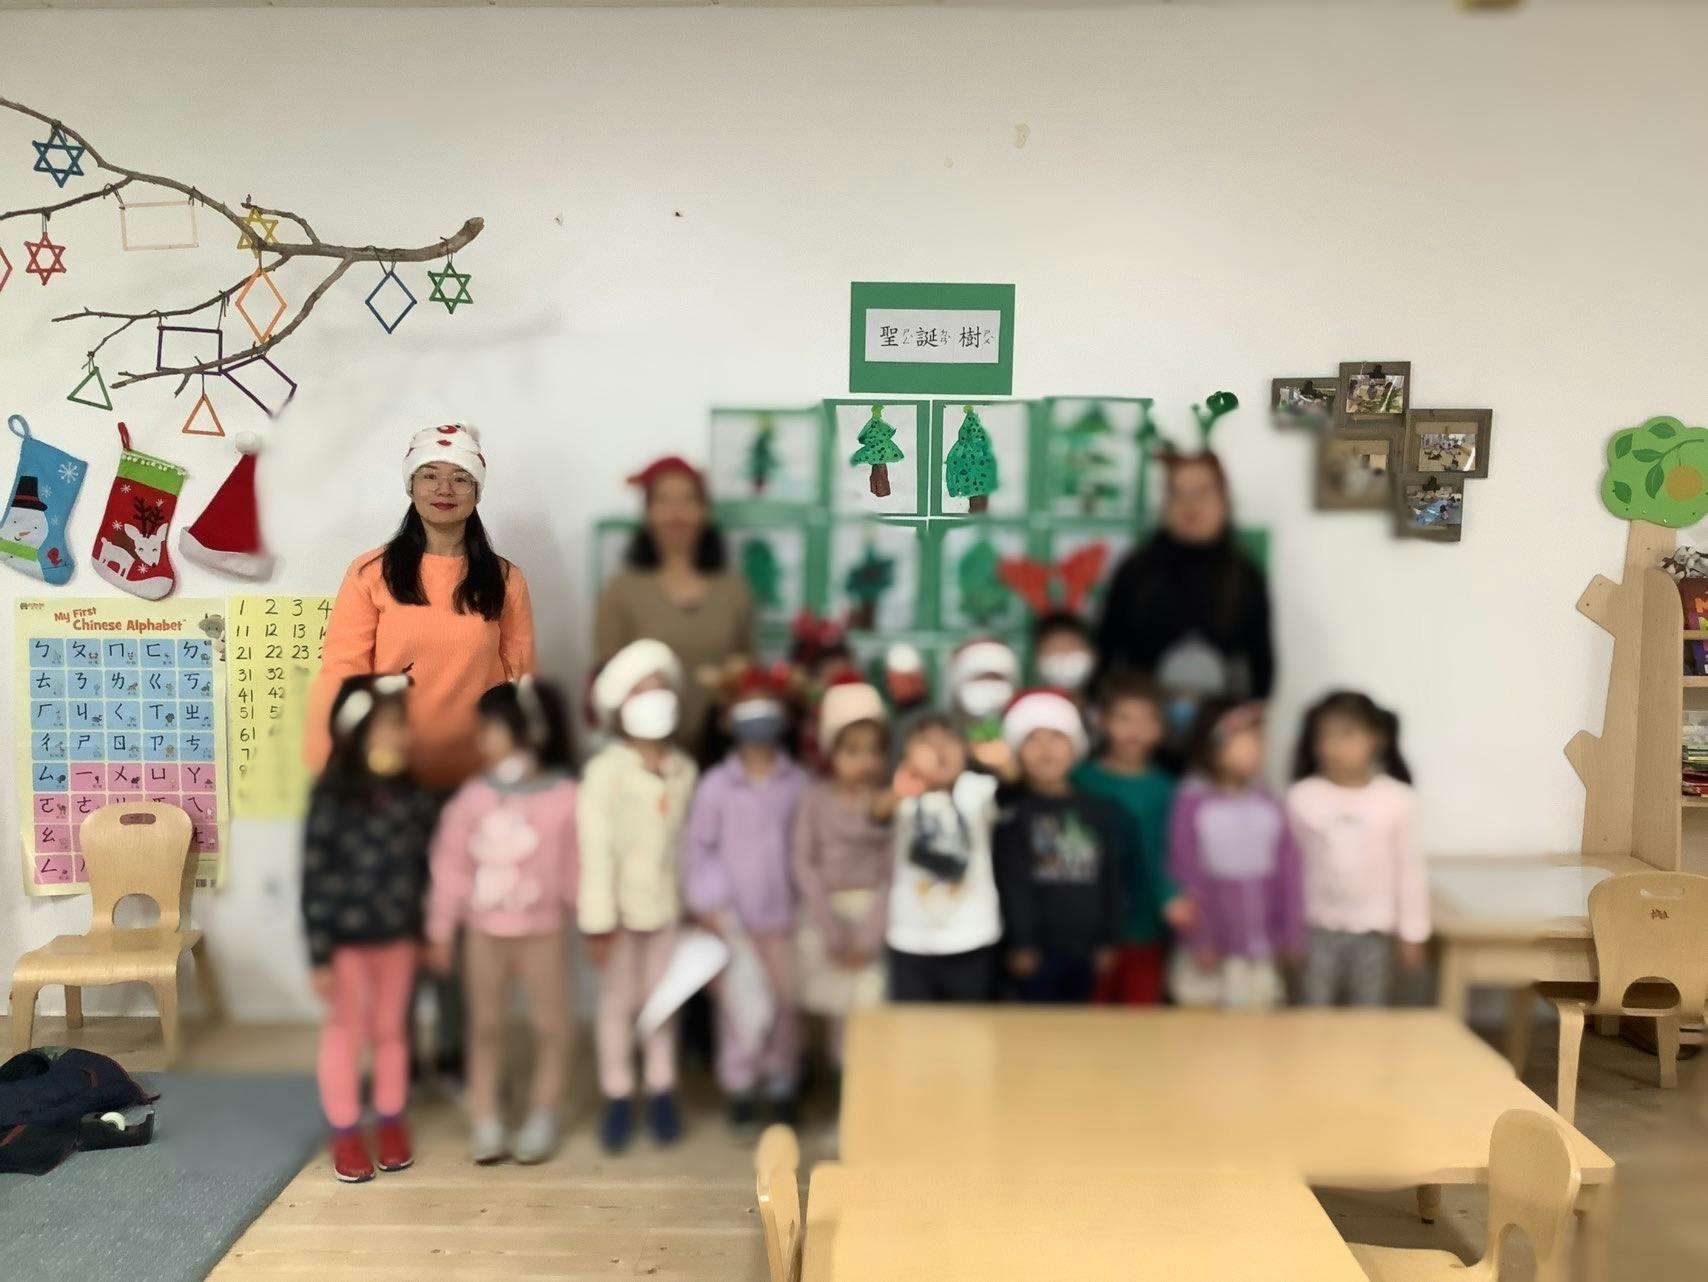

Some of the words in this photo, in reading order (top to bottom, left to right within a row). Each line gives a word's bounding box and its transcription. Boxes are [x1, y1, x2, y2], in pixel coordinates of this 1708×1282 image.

[880, 325, 982, 348] 聖誕樹
[54, 612, 70, 623] My
[73, 606, 97, 619] First
[239, 599, 245, 616] 1
[265, 598, 279, 615] 2
[292, 598, 303, 617] 3
[317, 599, 333, 621] 4
[73, 618, 122, 631] Chinese
[126, 618, 183, 634] Alphabet
[236, 625, 250, 637] 11
[265, 623, 278, 638] 12
[292, 623, 306, 639] 13
[235, 646, 252, 660] 21
[264, 644, 283, 659] 22
[291, 644, 310, 660] 23
[238, 668, 252, 681] 31
[266, 667, 284, 680] 32
[238, 688, 253, 704] 41
[240, 705, 254, 719] 51
[240, 727, 255, 742] 61
